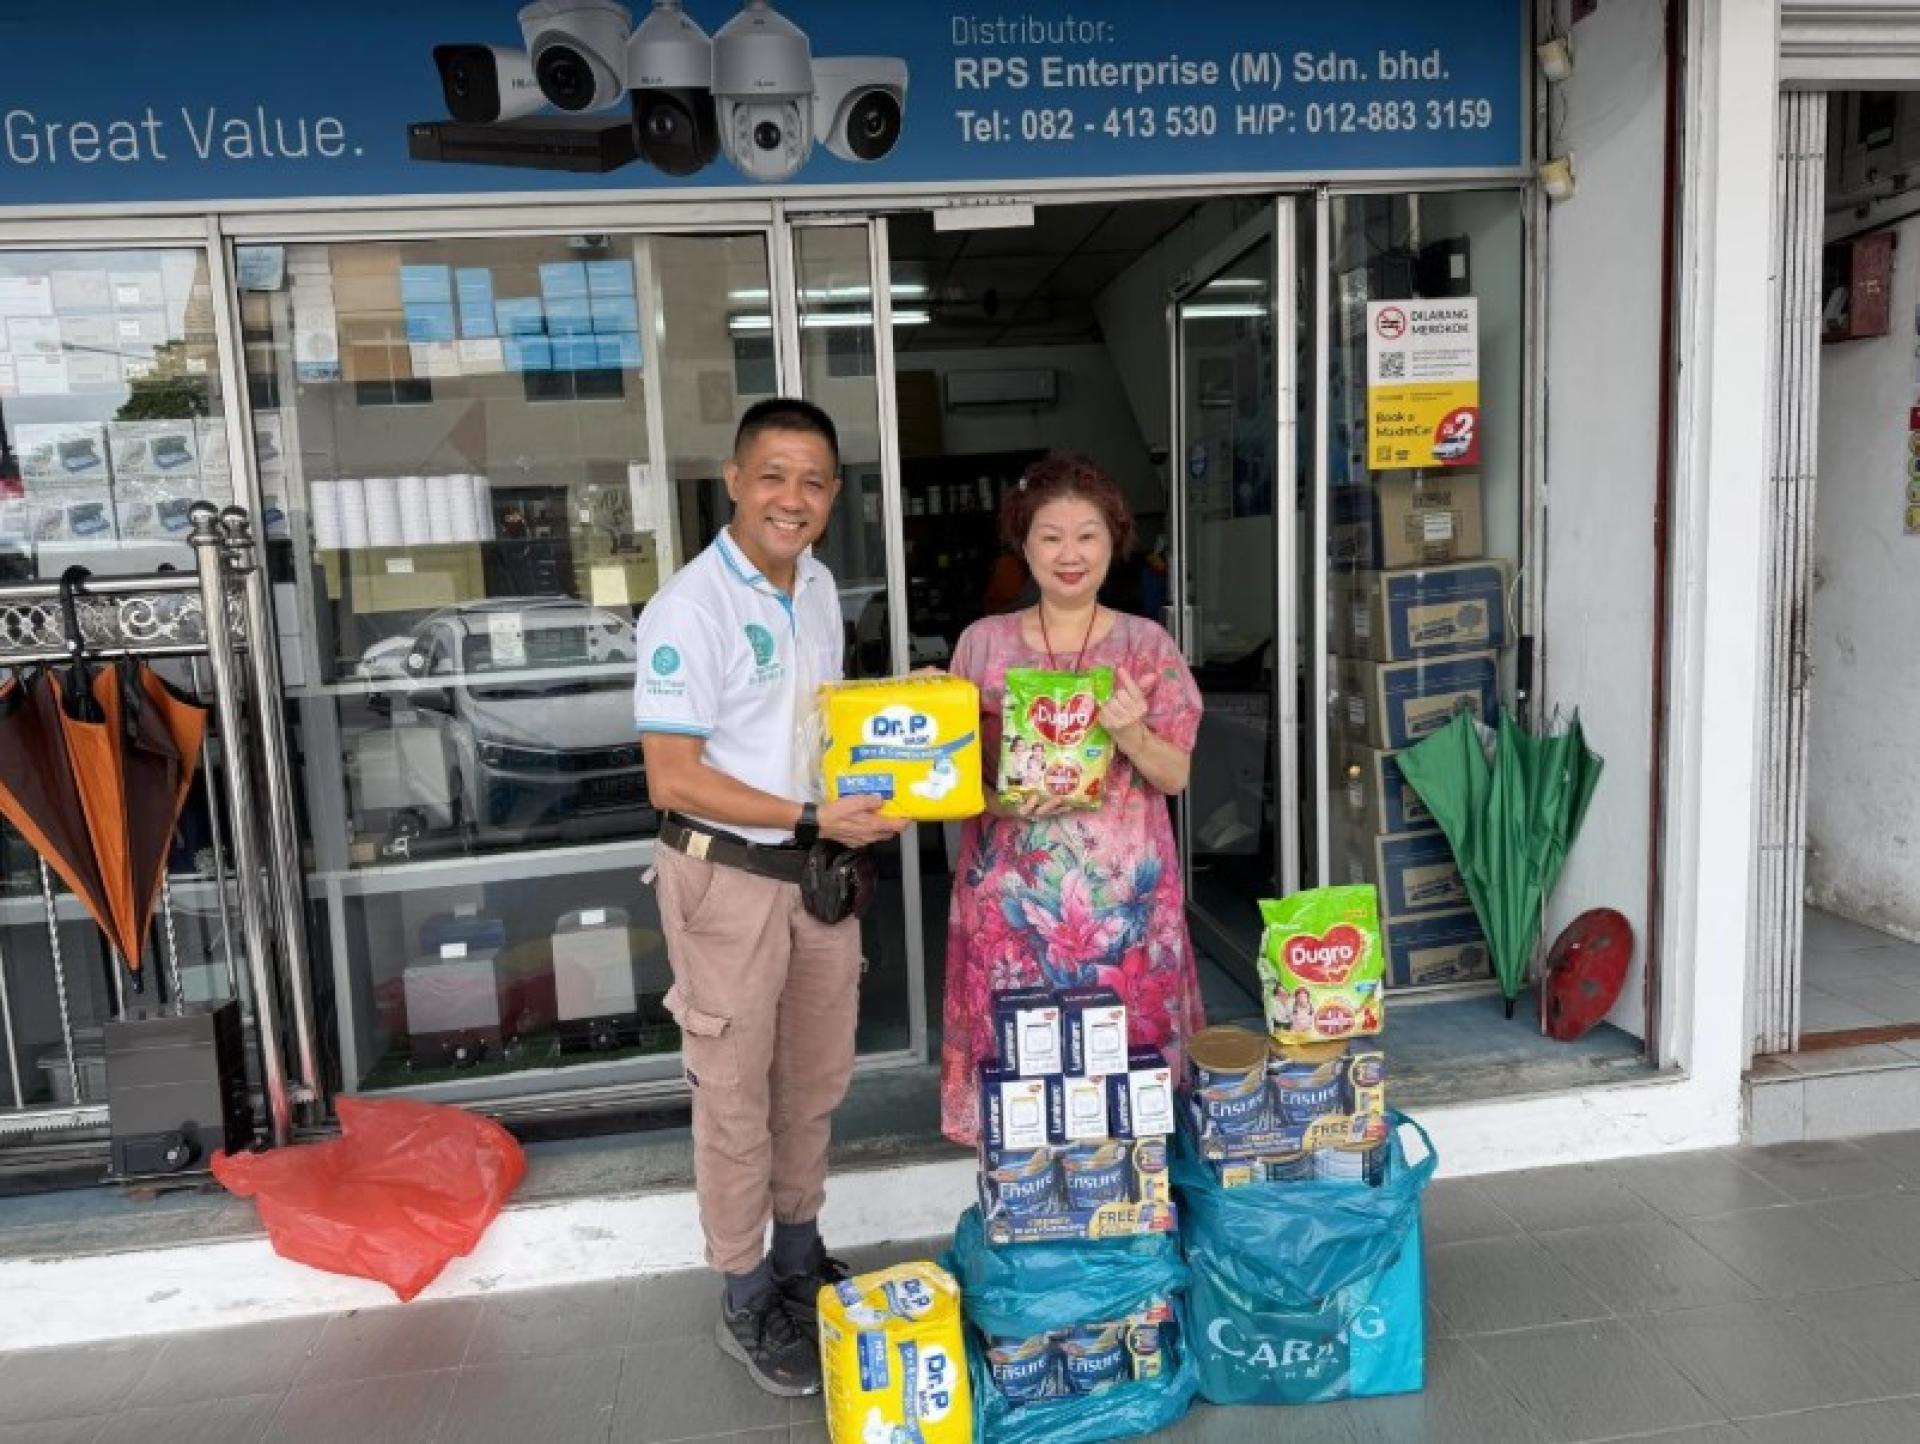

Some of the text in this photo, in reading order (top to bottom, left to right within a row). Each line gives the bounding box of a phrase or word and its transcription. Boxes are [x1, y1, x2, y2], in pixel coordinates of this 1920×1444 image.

[951, 14, 1115, 45] Distributor:
[954, 49, 1450, 93] RPS Enterprise (M) Sdn. bhd.
[4, 104, 363, 164] Great Value.
[955, 110, 1010, 142] Tel:
[1021, 109, 1074, 140] 082
[1103, 107, 1155, 138] 413
[1166, 105, 1217, 137] 530
[1236, 103, 1296, 134] H/P:
[1306, 101, 1416, 133] 012-883
[1426, 98, 1492, 129] 3159
[1411, 308, 1468, 322] DILARANG
[1291, 945, 1354, 966] Dugro
